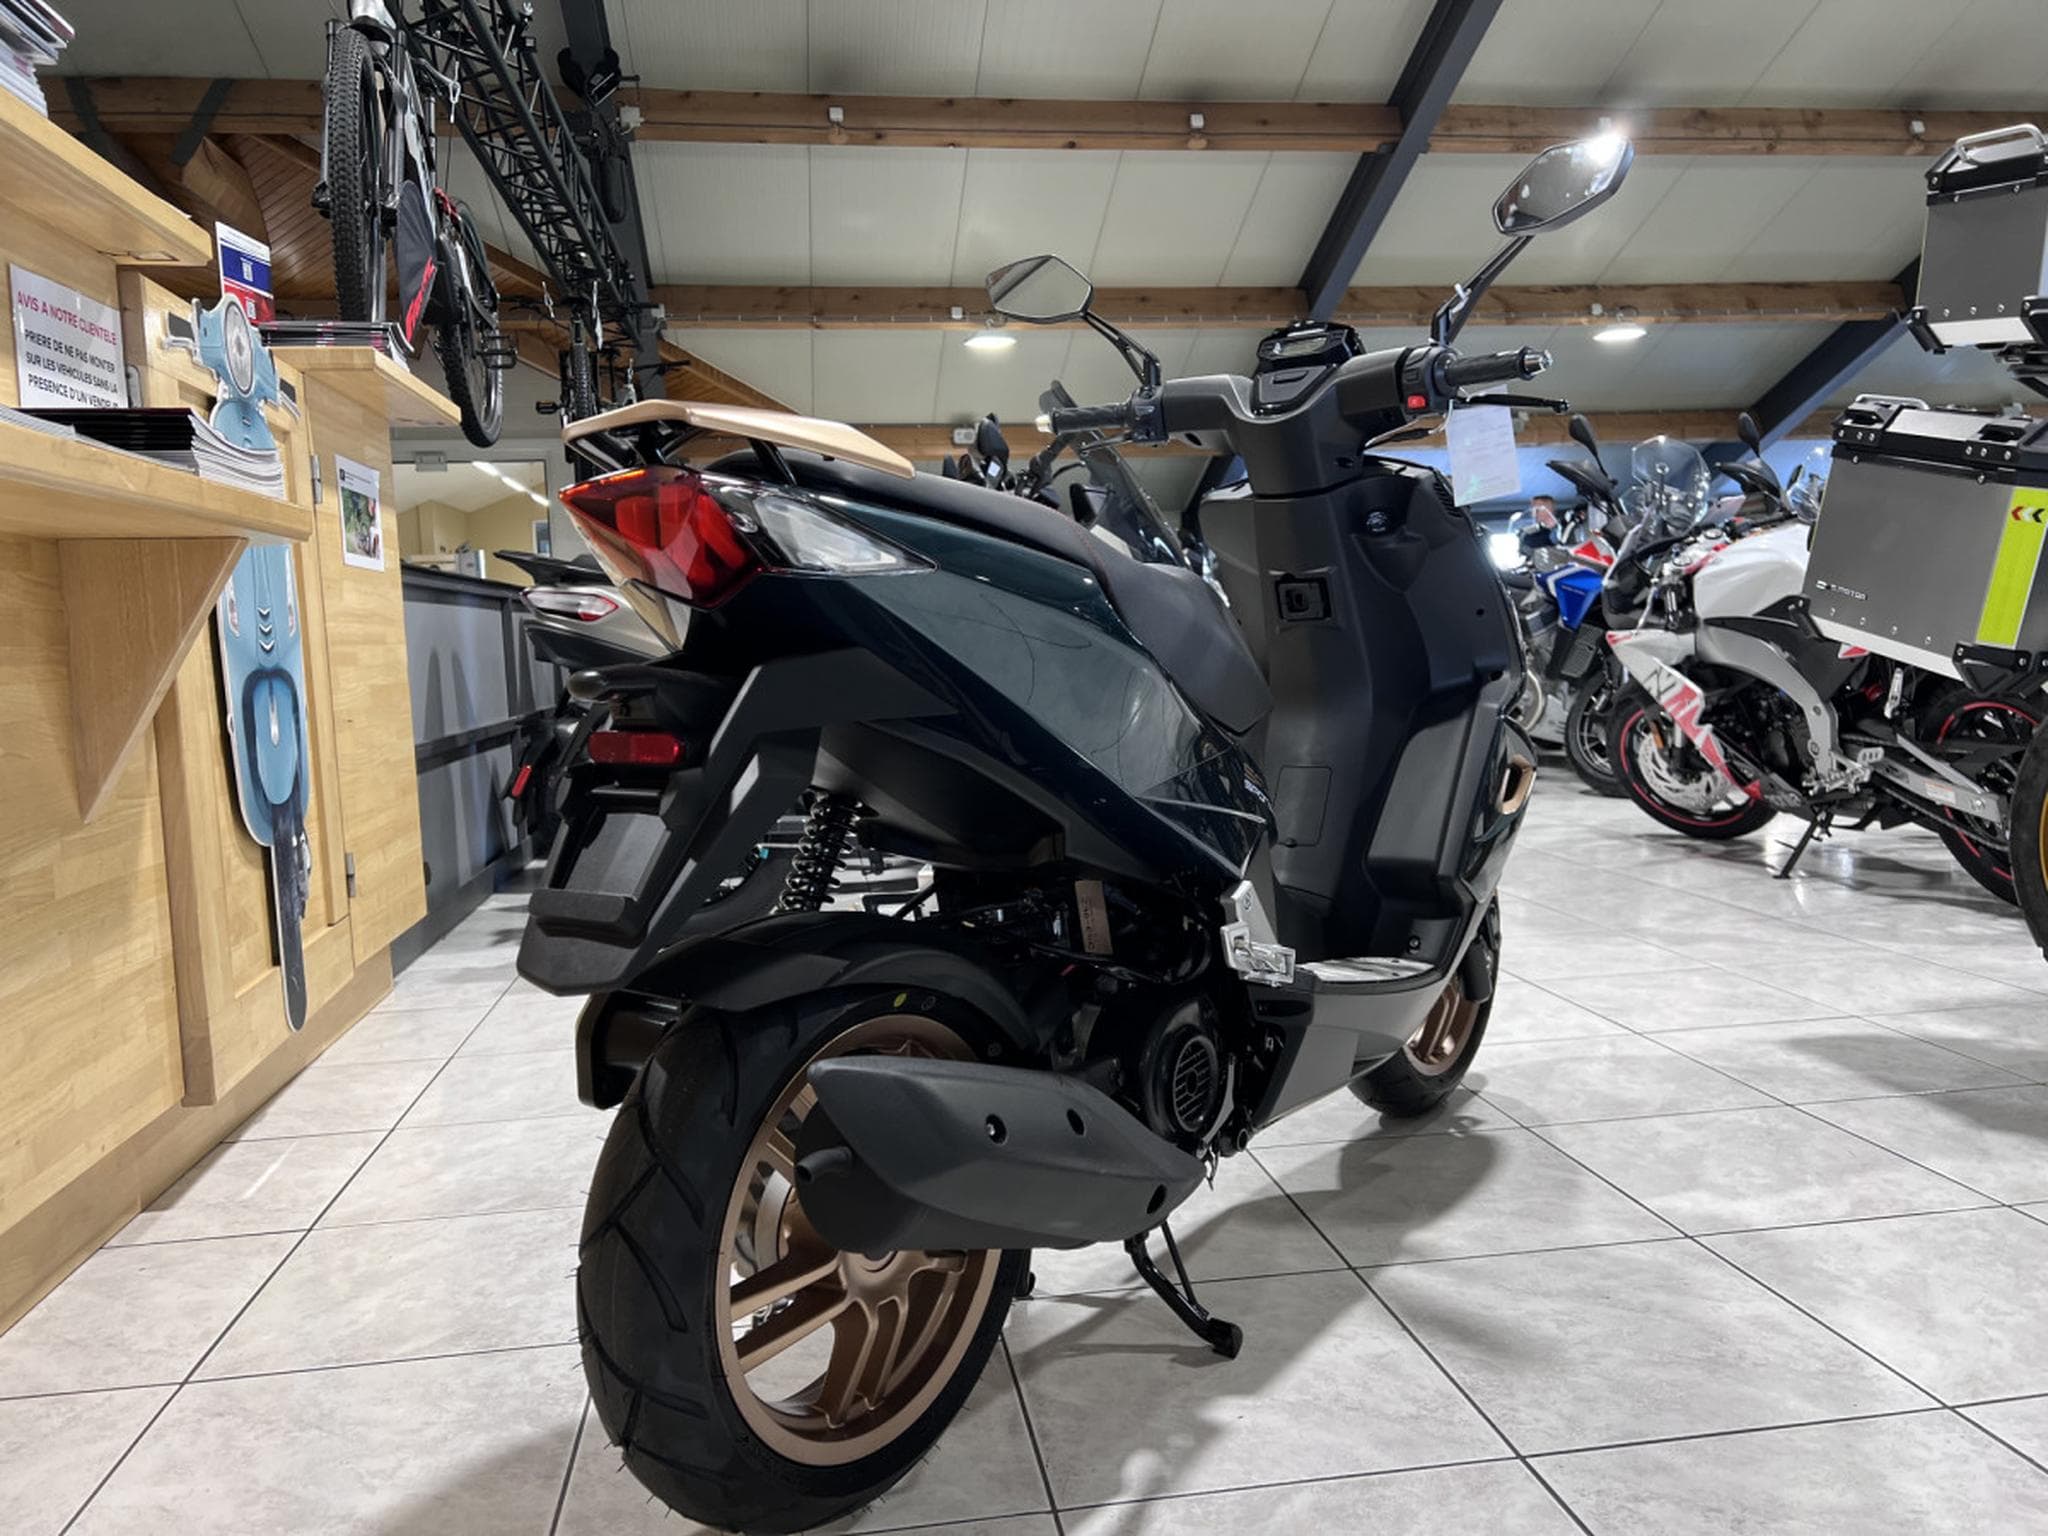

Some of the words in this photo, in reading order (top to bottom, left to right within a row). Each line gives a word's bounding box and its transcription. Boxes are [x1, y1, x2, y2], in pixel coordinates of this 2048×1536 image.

[18, 290, 39, 312] AVIS
[42, 301, 49, 316] A
[50, 304, 78, 329] NOTRE
[80, 317, 117, 347] CLIENTELE
[25, 328, 52, 350] PRIERE
[53, 339, 64, 354] DE
[65, 344, 74, 359] NE
[75, 348, 88, 364] PAS
[89, 354, 115, 373] MONTER
[26, 351, 42, 368] SUR
[43, 357, 56, 372] LES
[56, 361, 92, 385] VEHICULES
[93, 375, 109, 391] SANS
[110, 382, 118, 394] LA
[28, 372, 68, 399] PRESENCE
[69, 386, 87, 404] D'UN
